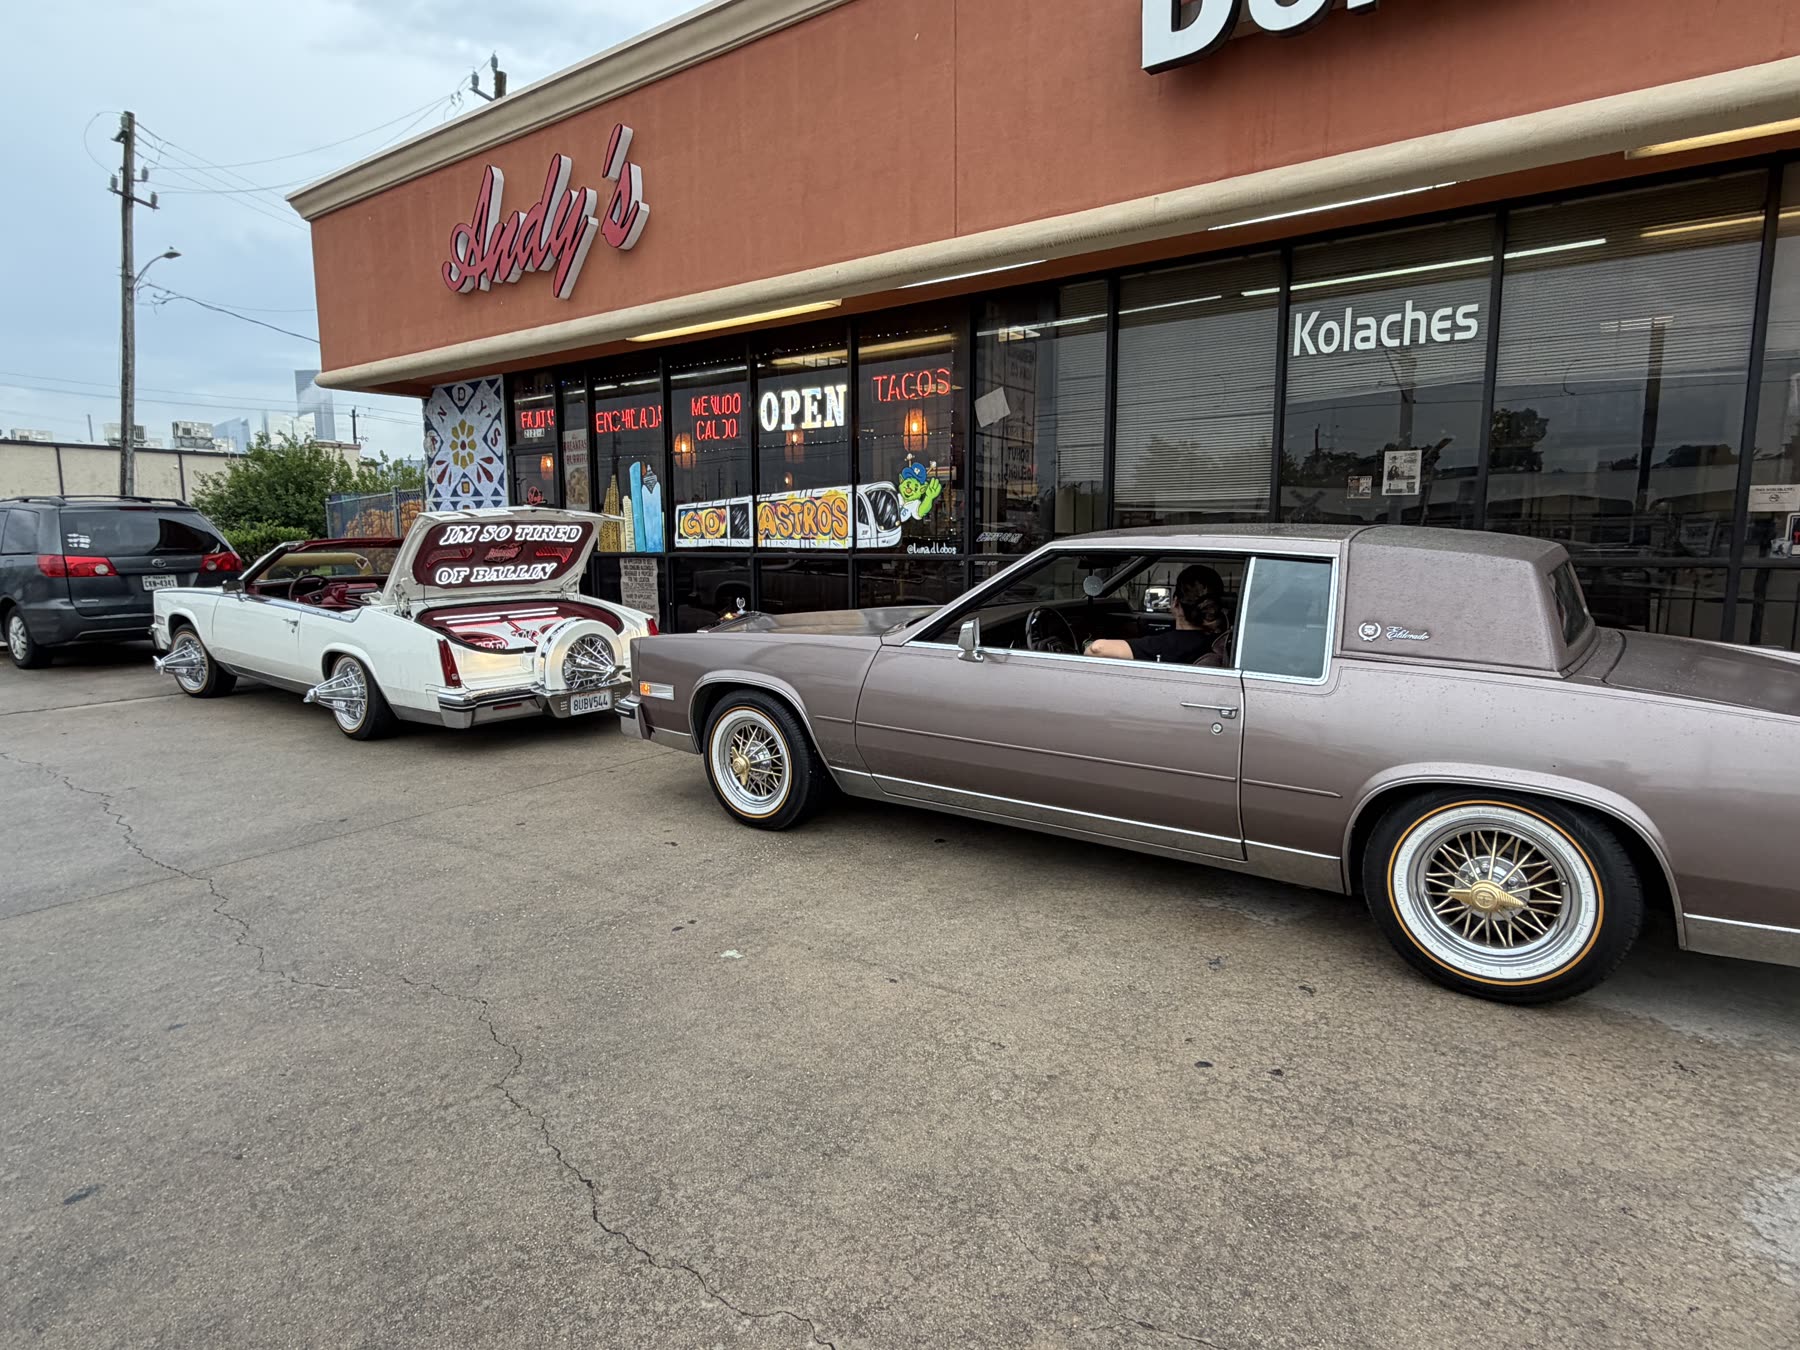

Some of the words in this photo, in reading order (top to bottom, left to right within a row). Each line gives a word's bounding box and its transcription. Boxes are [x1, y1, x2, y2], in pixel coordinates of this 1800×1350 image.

[442, 122, 650, 301] Andy's
[1293, 299, 1479, 357] Kolaches
[872, 368, 950, 402] TACOS
[691, 392, 742, 416] MENUDO
[760, 384, 848, 432] OPEN
[696, 418, 737, 441] CALDO
[683, 510, 721, 537] GO
[759, 497, 848, 541] ASTROS
[439, 525, 480, 545] IM
[479, 525, 512, 542] SO
[515, 525, 582, 543] TIRED
[436, 567, 469, 584] OF
[470, 563, 557, 582] BALLIN
[573, 694, 608, 712] 8UBV544
